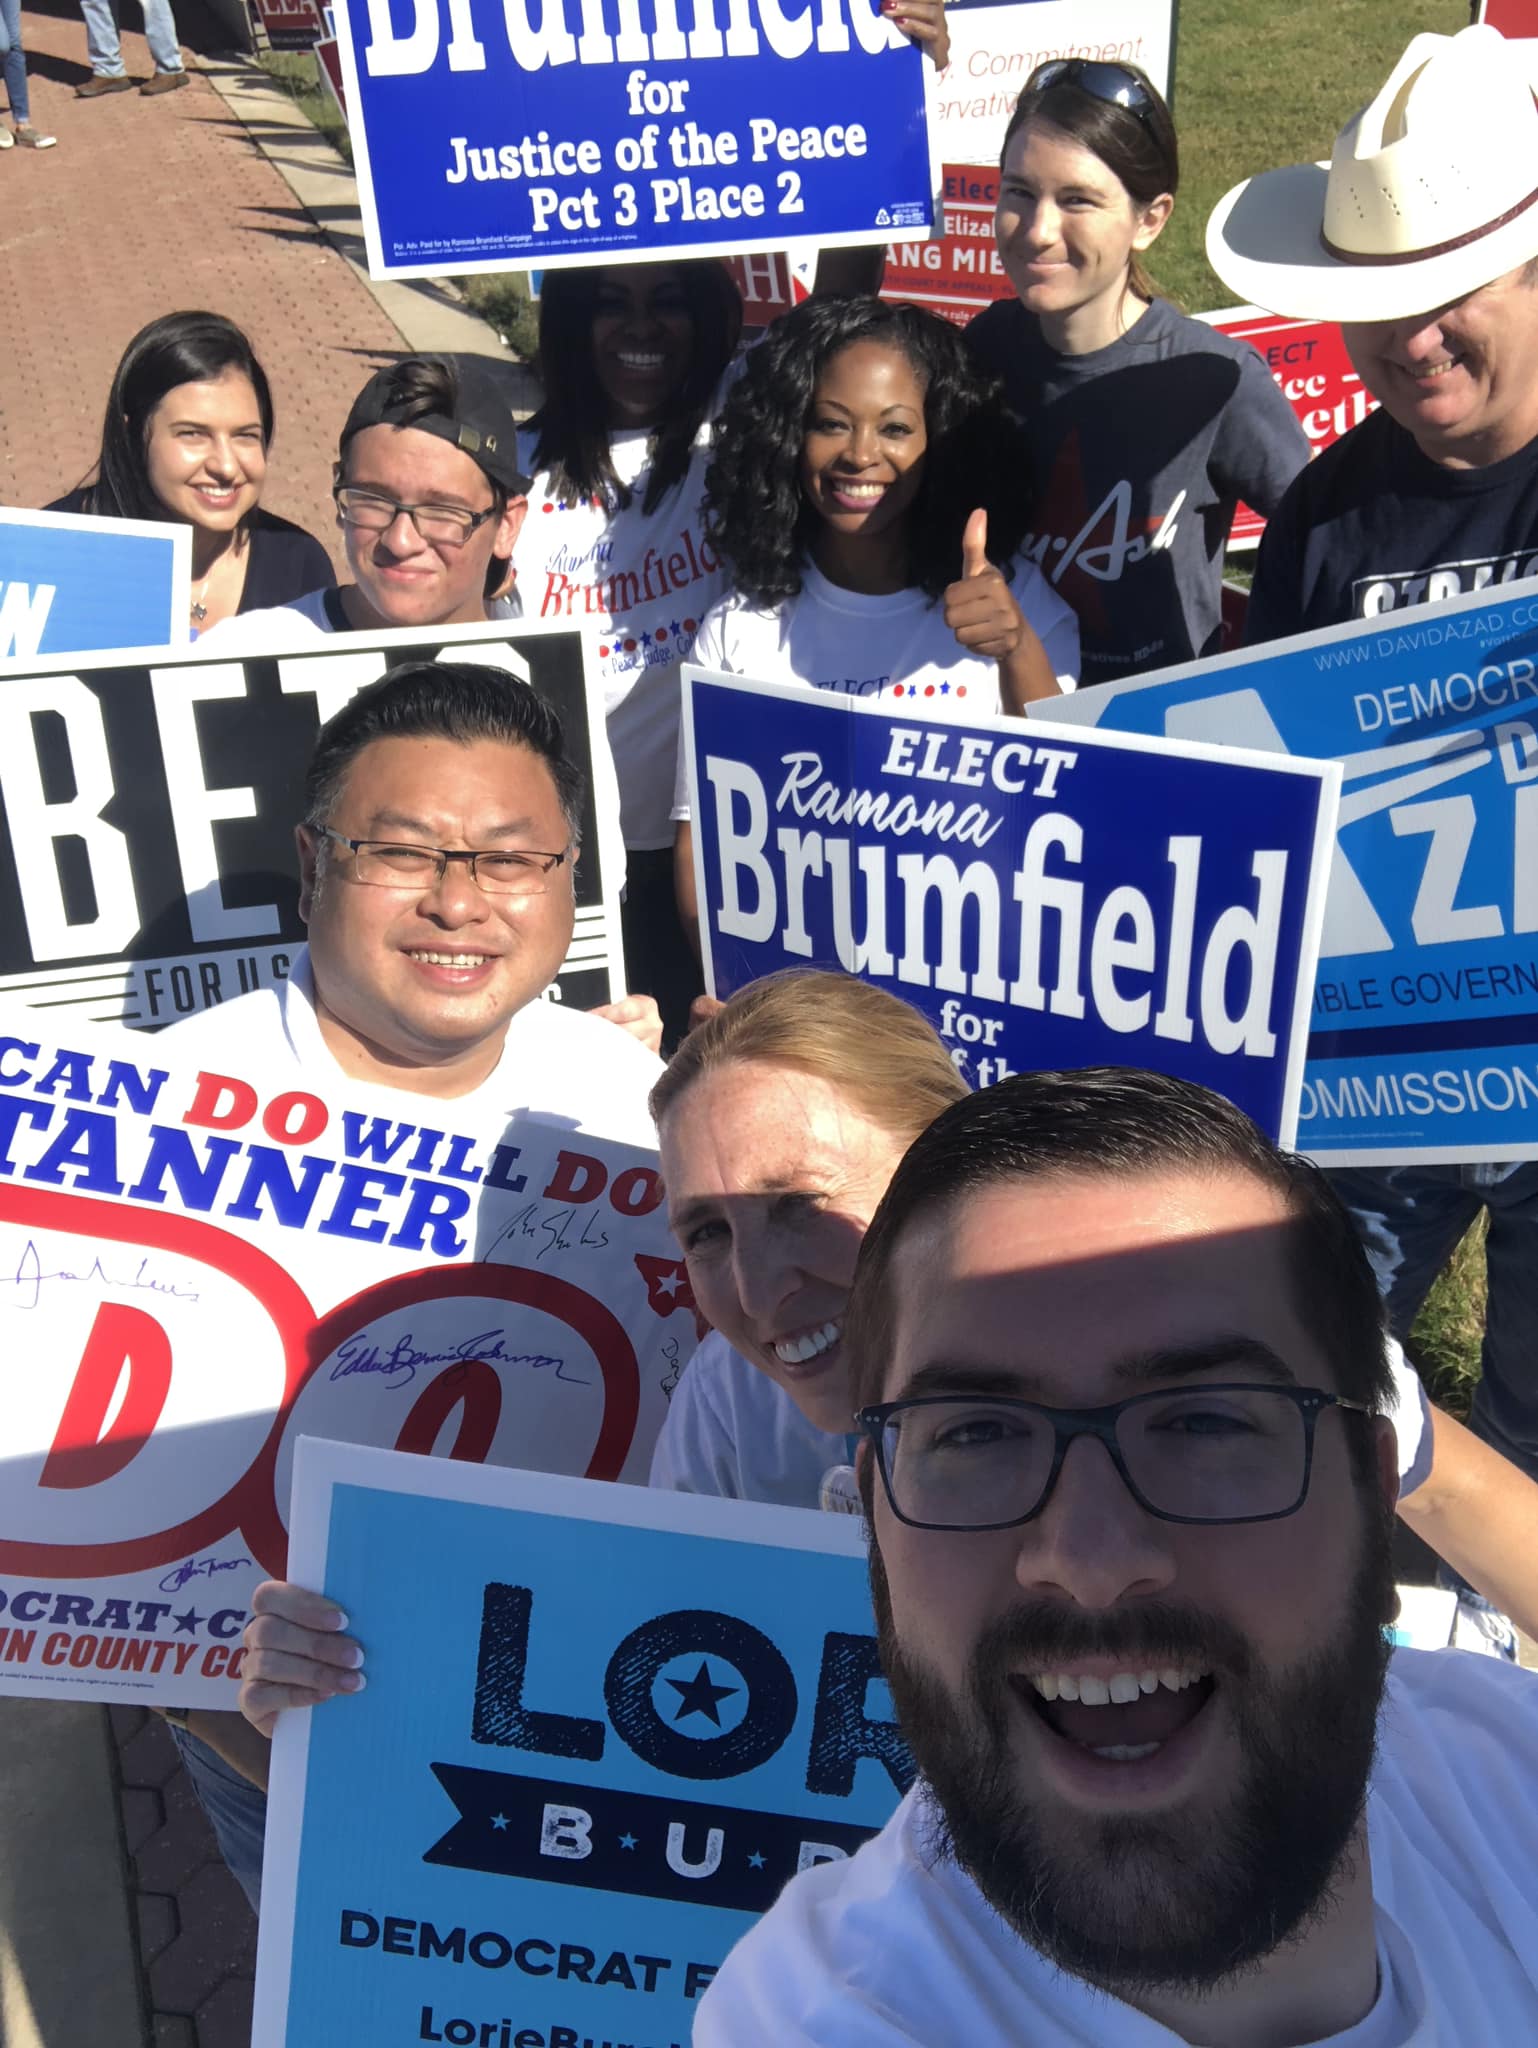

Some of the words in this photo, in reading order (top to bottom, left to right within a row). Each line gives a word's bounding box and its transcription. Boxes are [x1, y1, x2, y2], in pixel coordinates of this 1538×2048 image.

[627, 70, 689, 115] for
[446, 131, 601, 184] Justice
[614, 126, 659, 170] of
[669, 121, 738, 165] the
[750, 117, 868, 161] Peace
[529, 188, 601, 233] Pct
[614, 184, 637, 226] 3
[651, 175, 766, 221] Place
[777, 171, 804, 214] 2
[945, 176, 1000, 200] Elec
[881, 728, 1078, 798] ELECT
[776, 752, 1004, 848] Ramona
[705, 755, 1289, 1058] Brumfield
[145, 962, 223, 1016] FOR
[940, 1001, 1004, 1046] for
[0, 1036, 168, 1115] CAN
[182, 1071, 329, 1145] DO
[341, 1111, 528, 1193] WILL
[542, 1150, 666, 1217] DO
[0, 1094, 472, 1257] TANNER
[41, 1632, 200, 1675] COUNTY
[340, 1909, 672, 1993] DEMOCRAT
